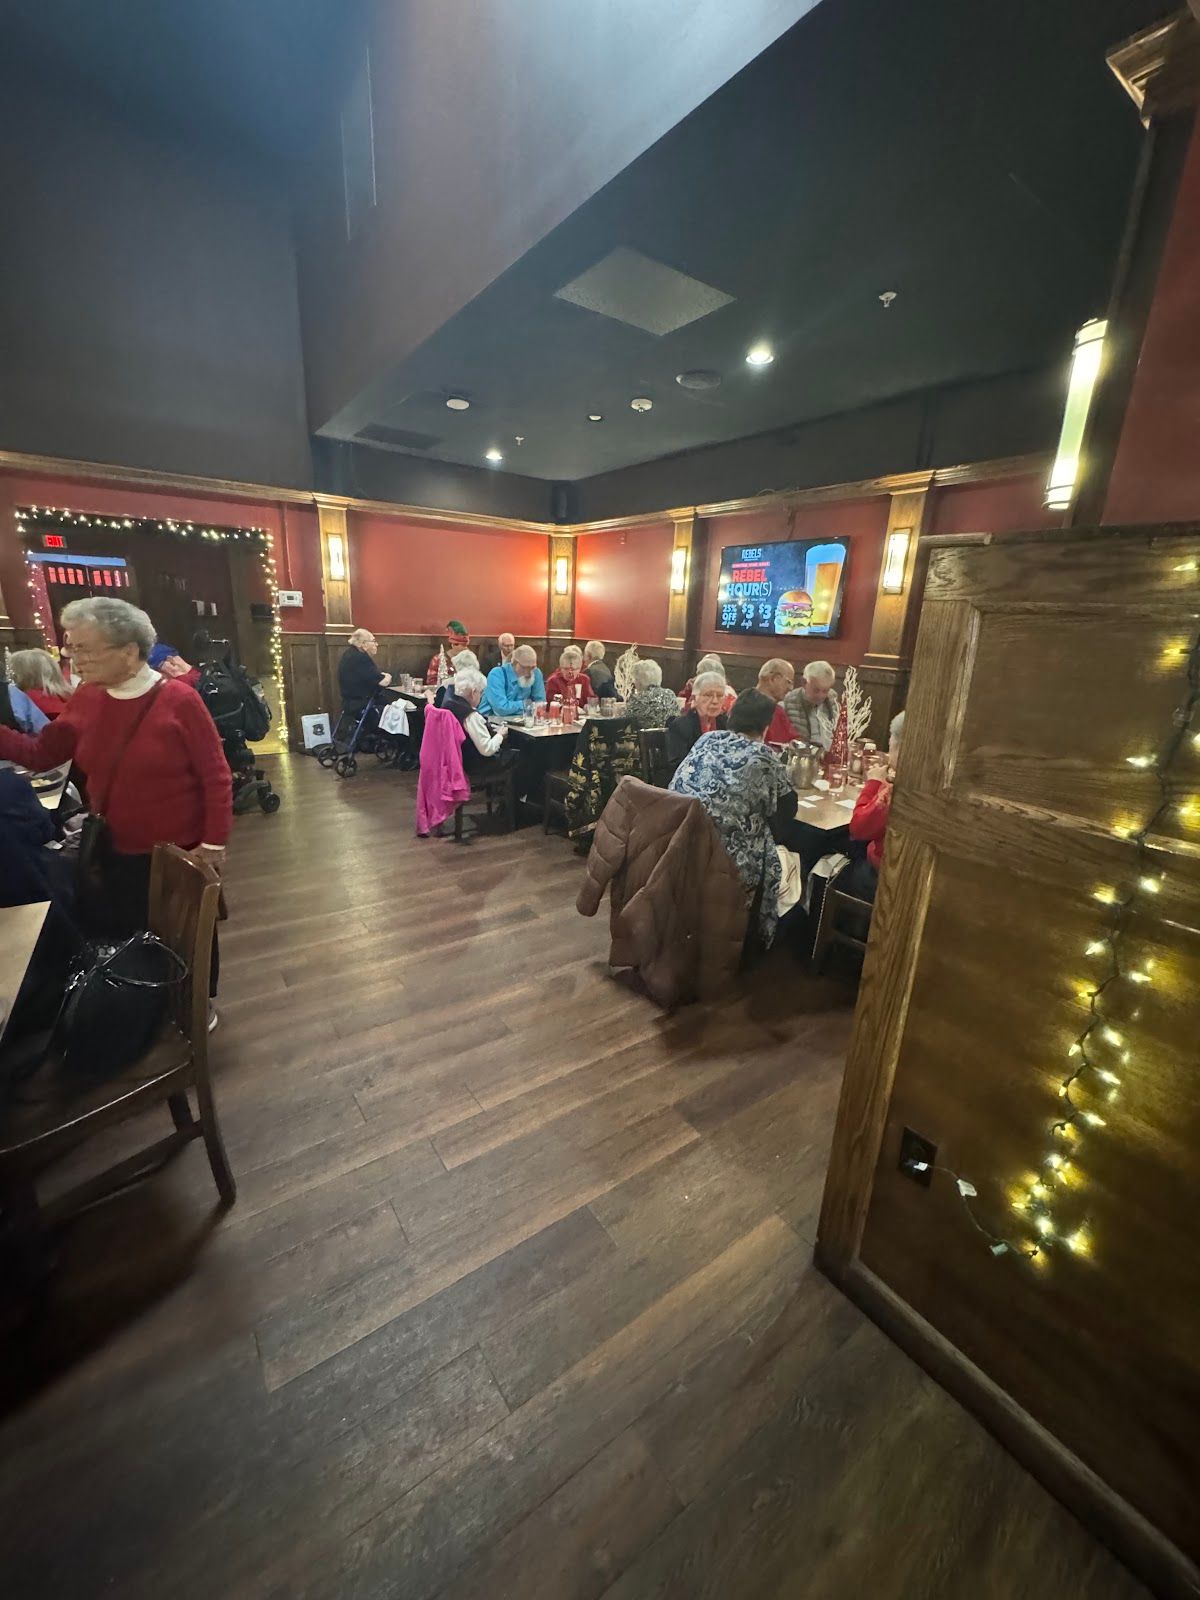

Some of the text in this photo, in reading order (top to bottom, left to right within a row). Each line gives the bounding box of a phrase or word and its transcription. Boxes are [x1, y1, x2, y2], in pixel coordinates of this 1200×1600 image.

[733, 569, 767, 582] REBEL
[726, 581, 772, 596] HOUR(S)
[722, 612, 737, 620] OFF
[741, 602, 754, 619] $3
[758, 602, 772, 619] $3
